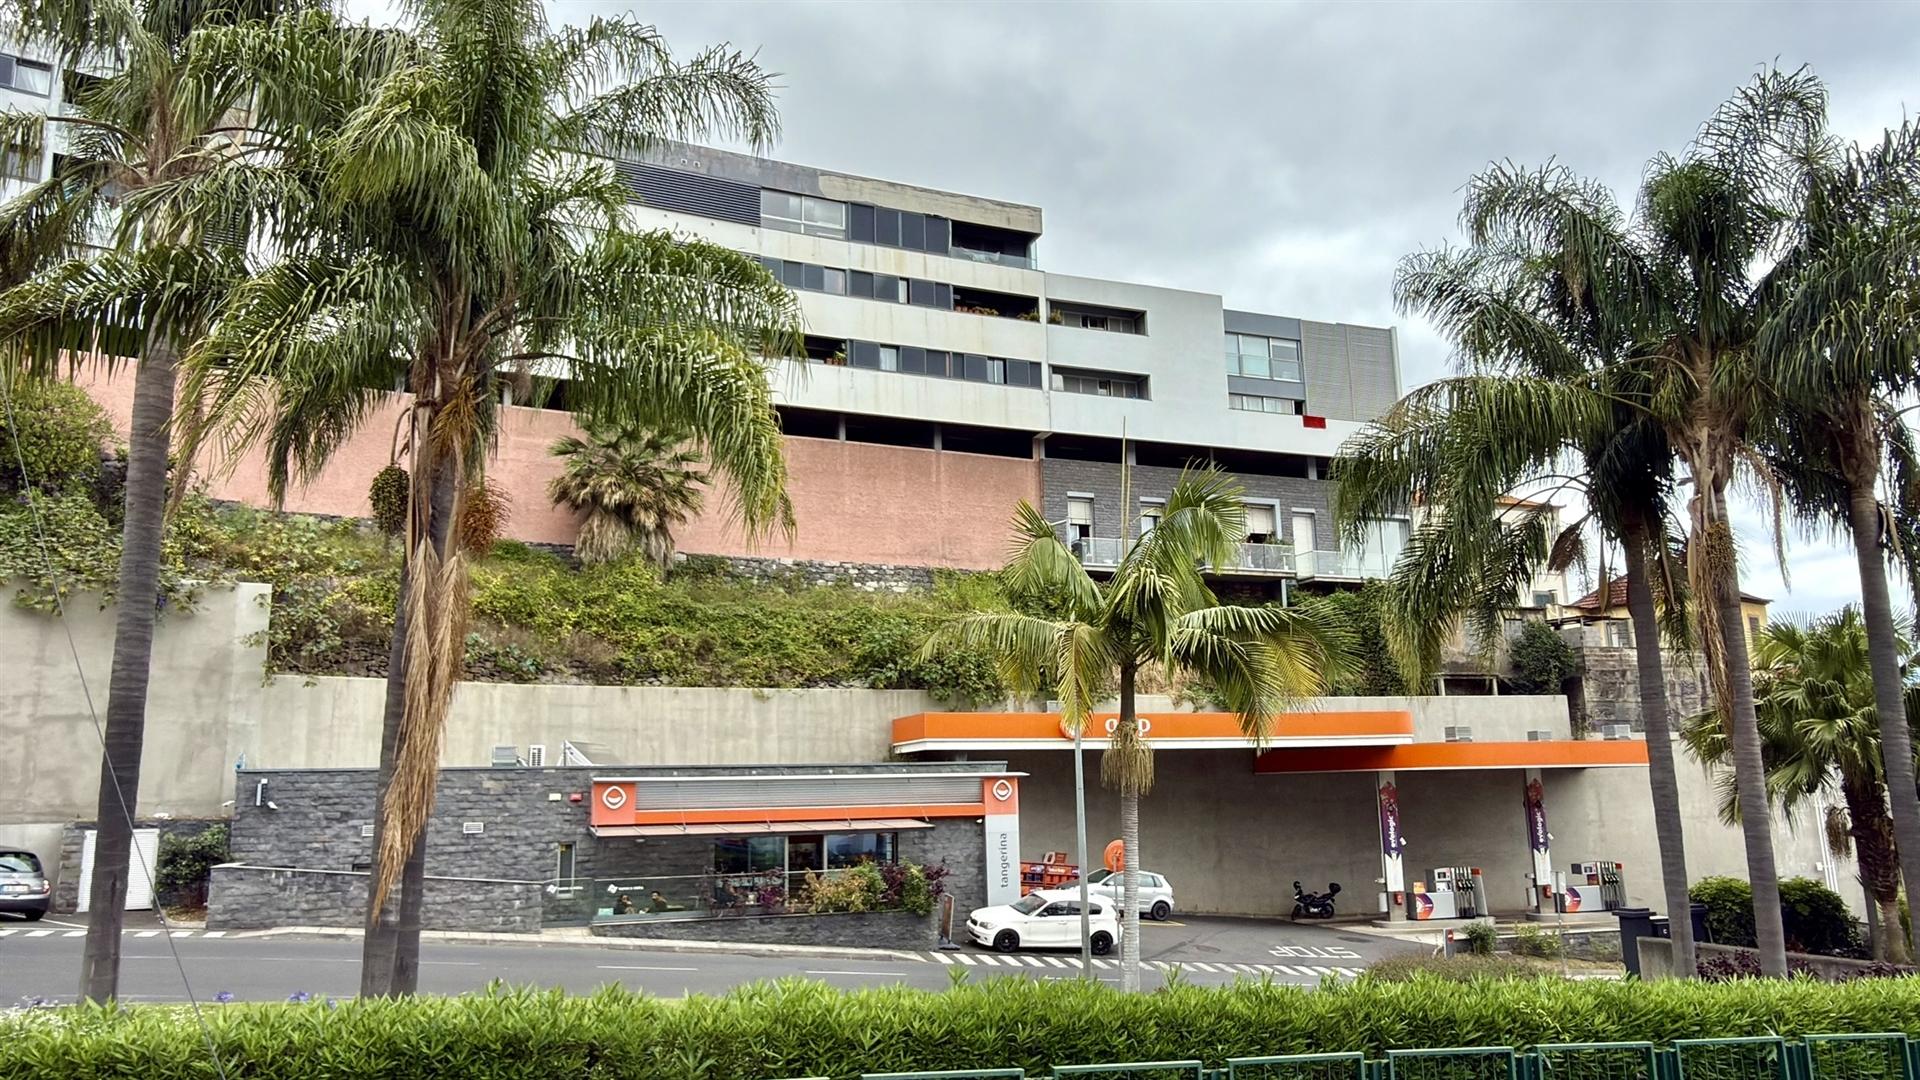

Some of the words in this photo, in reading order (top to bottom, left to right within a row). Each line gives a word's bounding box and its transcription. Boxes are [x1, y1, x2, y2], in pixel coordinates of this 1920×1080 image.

[1104, 718, 1151, 737] gp
[999, 833, 1010, 888] tangerina
[1268, 946, 1362, 958] STOP
